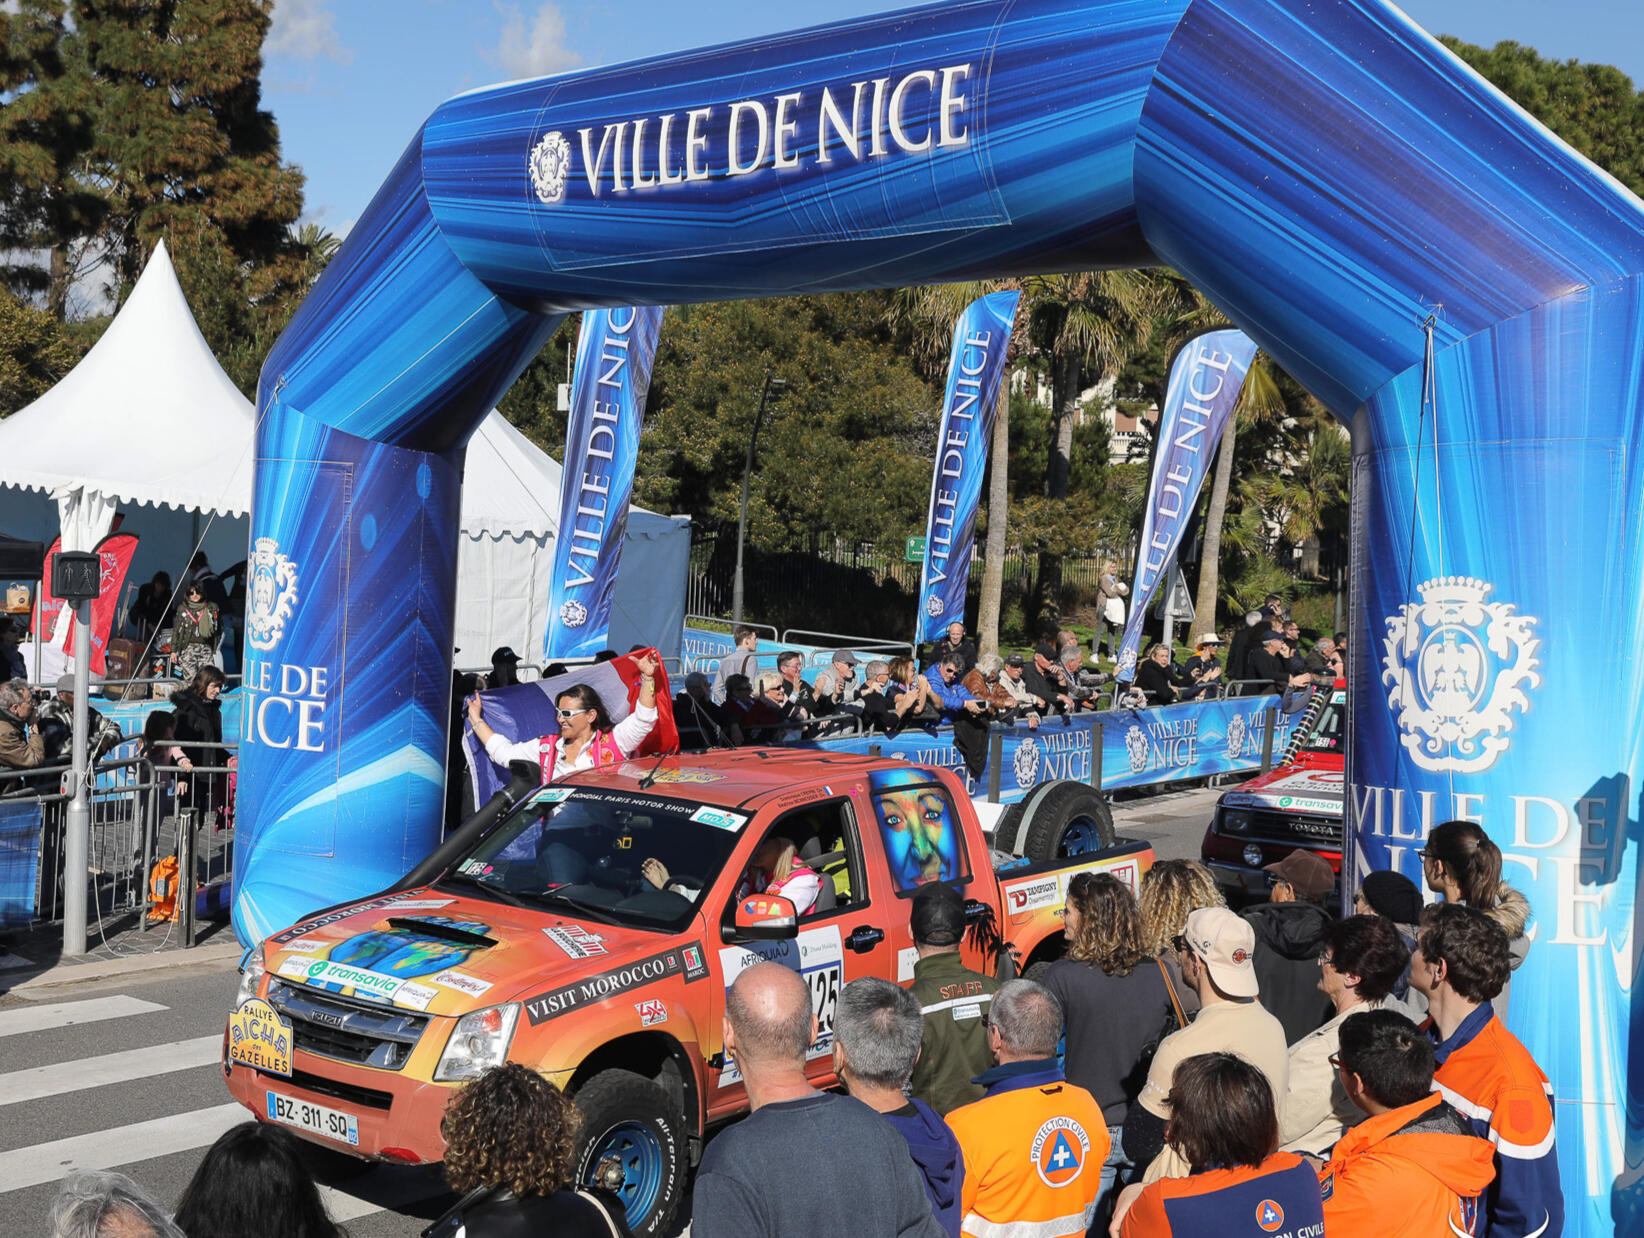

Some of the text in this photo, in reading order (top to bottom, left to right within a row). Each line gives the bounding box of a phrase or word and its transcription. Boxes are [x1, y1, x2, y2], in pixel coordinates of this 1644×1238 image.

[578, 63, 972, 197] VILLE DE NICE
[1174, 346, 1233, 457] NICE
[564, 306, 637, 591] VILLE DE NIC
[928, 330, 992, 587] VILLE DE NICE
[1159, 464, 1193, 521] DE
[684, 638, 733, 656] VILLE DE
[684, 653, 721, 676] NIC
[280, 663, 328, 698] DE
[1041, 729, 1091, 753] VILLE DE
[1147, 717, 1198, 741] VILLE DE
[916, 746, 958, 767] VILLE
[1152, 736, 1199, 770] NICE
[1041, 750, 1092, 782] NICE
[570, 792, 604, 802] MONDIAL
[604, 794, 631, 804] PARIS
[631, 799, 664, 809] MOTOR
[664, 804, 696, 815] SHOW
[1295, 799, 1344, 810] transav
[1350, 783, 1609, 850] VILLE DE
[1288, 822, 1335, 836] TOYOTA
[741, 947, 782, 967] AFRIQUIA
[327, 964, 399, 992] transavia
[687, 967, 706, 979] MAROC
[526, 959, 665, 1019] VISIT MOROCCO
[940, 981, 984, 1000] STAFF
[244, 1005, 273, 1022] RALLYE
[311, 1010, 342, 1026] ISUZU
[231, 1046, 289, 1073] GAZELLES
[1031, 1117, 1090, 1160] PROTECTION CIVILE
[1297, 1221, 1325, 1238] CIVILE
